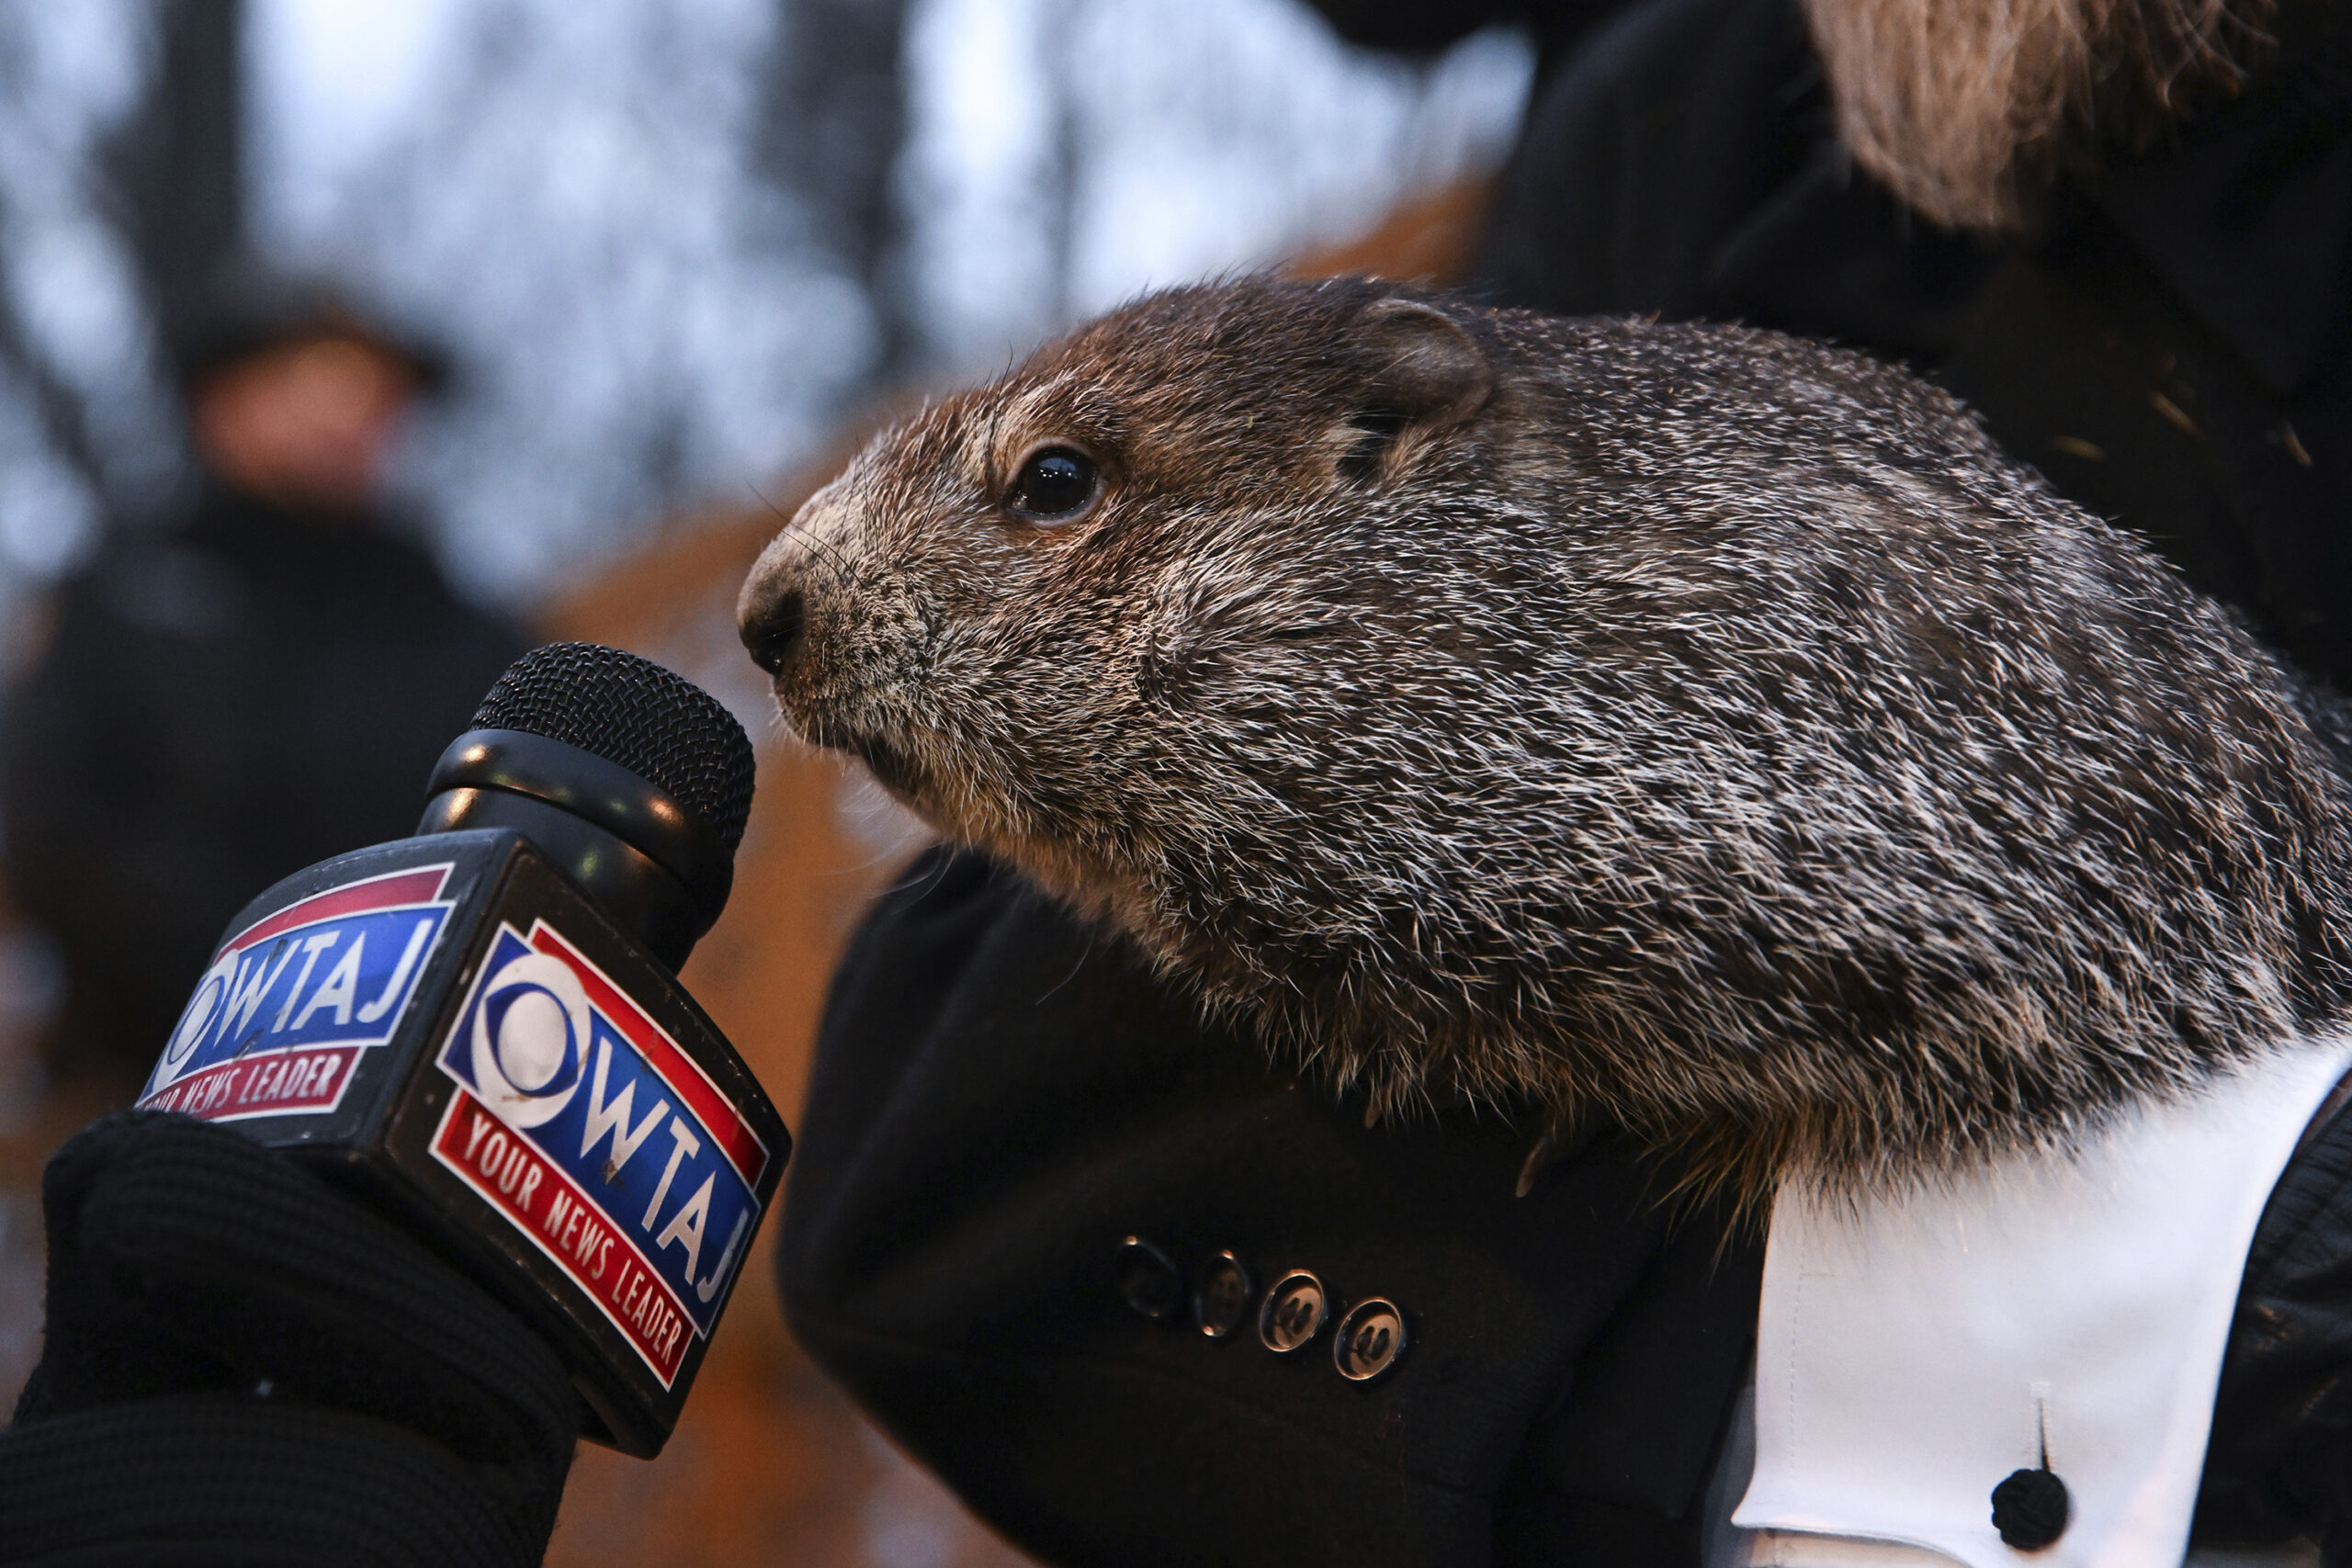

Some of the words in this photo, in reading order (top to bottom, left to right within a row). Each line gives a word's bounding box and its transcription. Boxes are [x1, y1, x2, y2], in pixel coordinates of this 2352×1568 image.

[212, 919, 435, 1050] WTAJ
[179, 1067, 242, 1114] NEWS
[237, 1054, 342, 1104] LEADER
[580, 1036, 749, 1303] WTAJ
[464, 1111, 543, 1213] YOUR
[544, 1190, 615, 1280] NEWS
[611, 1258, 683, 1366] LEADER
